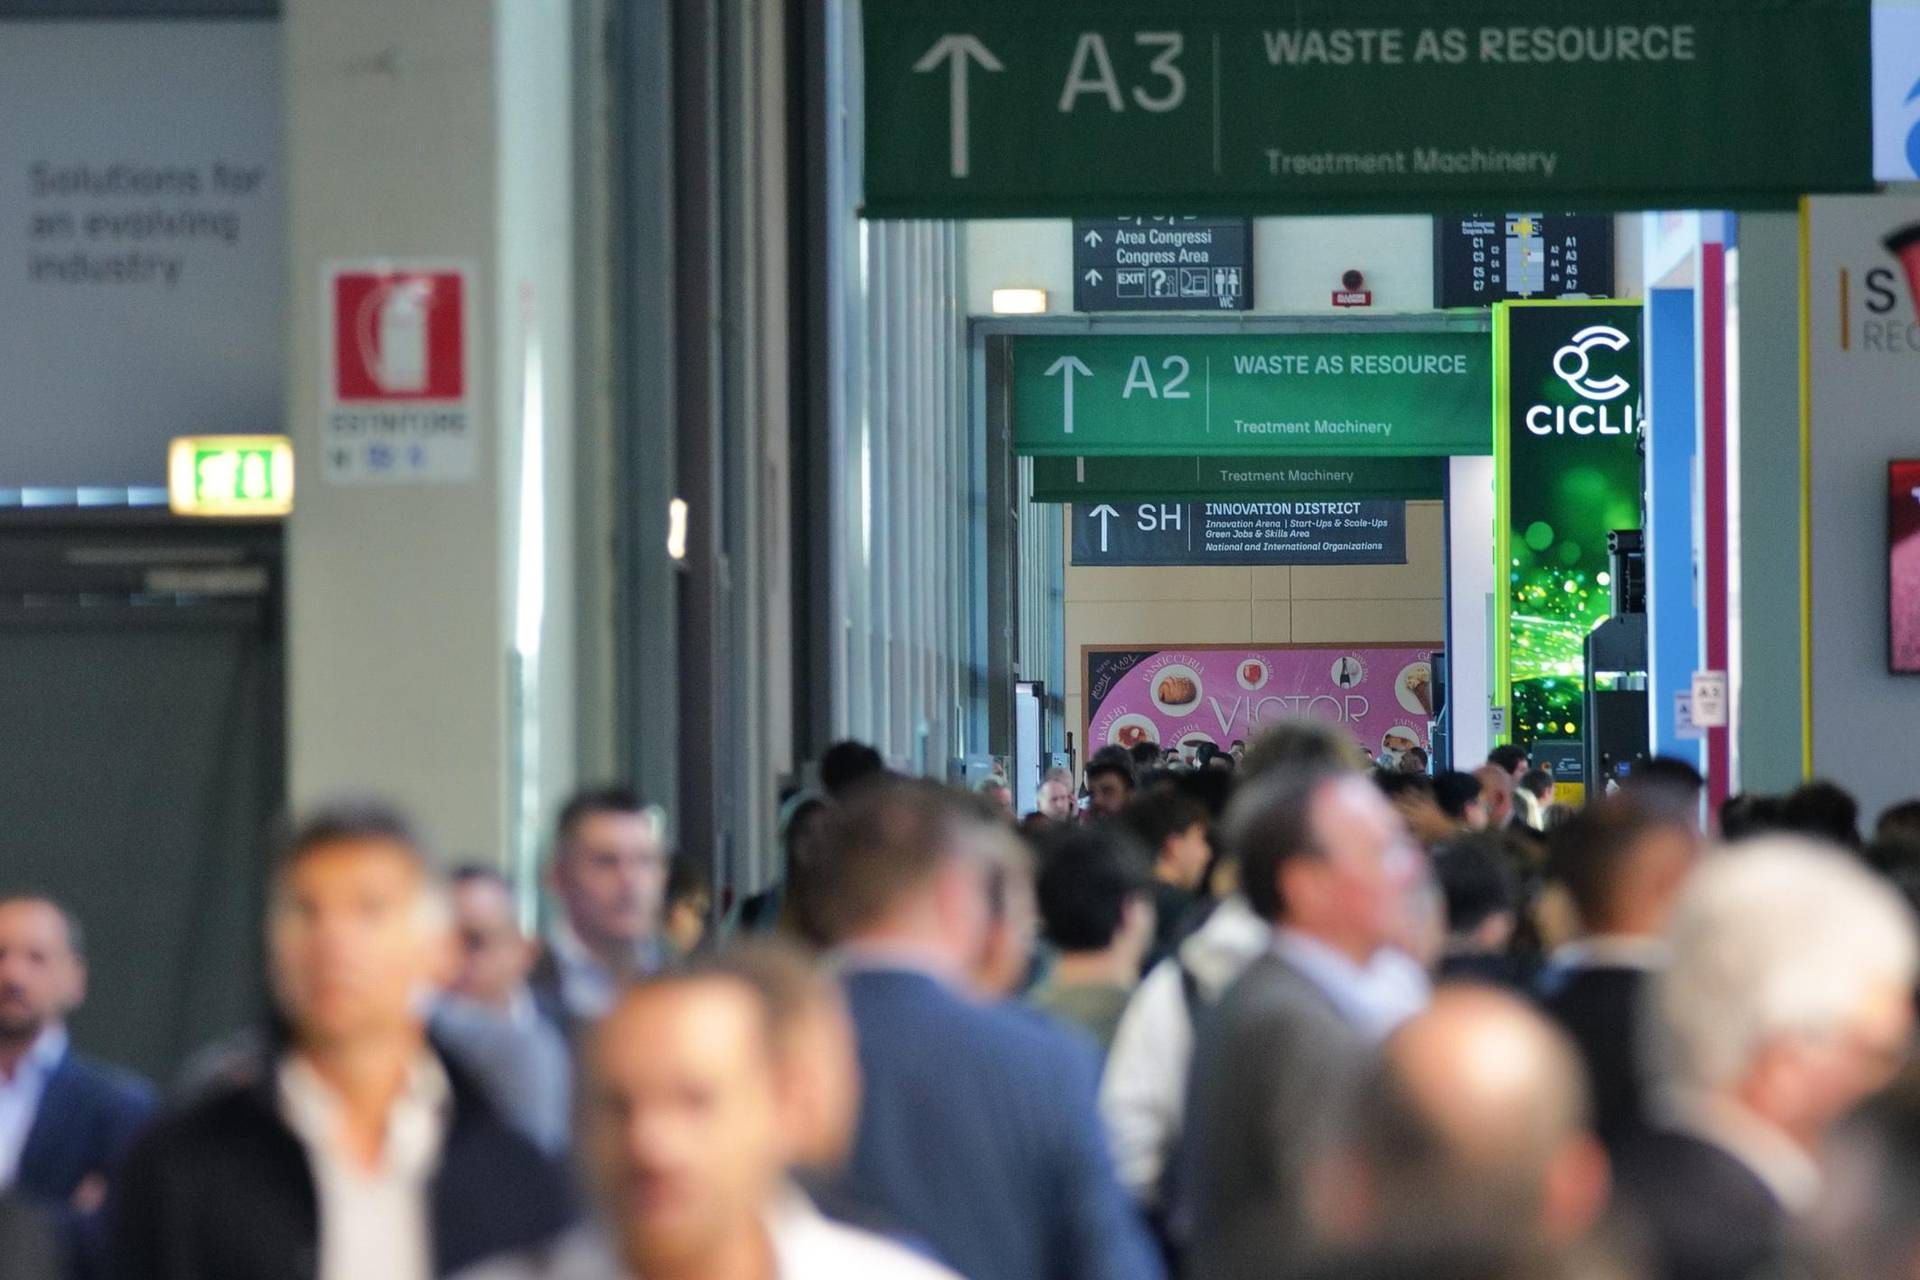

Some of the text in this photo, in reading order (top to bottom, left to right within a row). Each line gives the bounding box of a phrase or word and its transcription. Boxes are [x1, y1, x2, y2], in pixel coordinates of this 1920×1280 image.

[1263, 25, 1696, 64] WASTE AS RESOURCE
[1058, 31, 1186, 113] A3
[1265, 147, 1558, 178] Treatment Machinery
[1116, 229, 1212, 247] Area Congressi
[1116, 248, 1209, 266] Congress Area
[1118, 272, 1145, 285] EXIT
[1219, 296, 1234, 308] WC
[1234, 355, 1467, 374] WASTE AS RESOURCE
[1122, 355, 1190, 398] A2
[1234, 419, 1392, 436] Treatment Machinery
[1220, 469, 1353, 483] Treatment Machinery
[1137, 504, 1181, 531] SH
[1205, 502, 1361, 515] INNOVATION DISTRICT
[1205, 519, 1253, 528] Innovation
[1255, 519, 1281, 528] Arena
[1290, 518, 1332, 529] Start-Ups
[1334, 519, 1342, 527] &
[1344, 518, 1388, 528] Scale-Ups
[1205, 530, 1231, 538] Green
[1233, 530, 1253, 538] Jobs
[1264, 530, 1288, 538] Skills
[1290, 530, 1310, 538] Area
[1205, 541, 1383, 553] National and International Organizations
[1208, 695, 1369, 737] VICTOR
